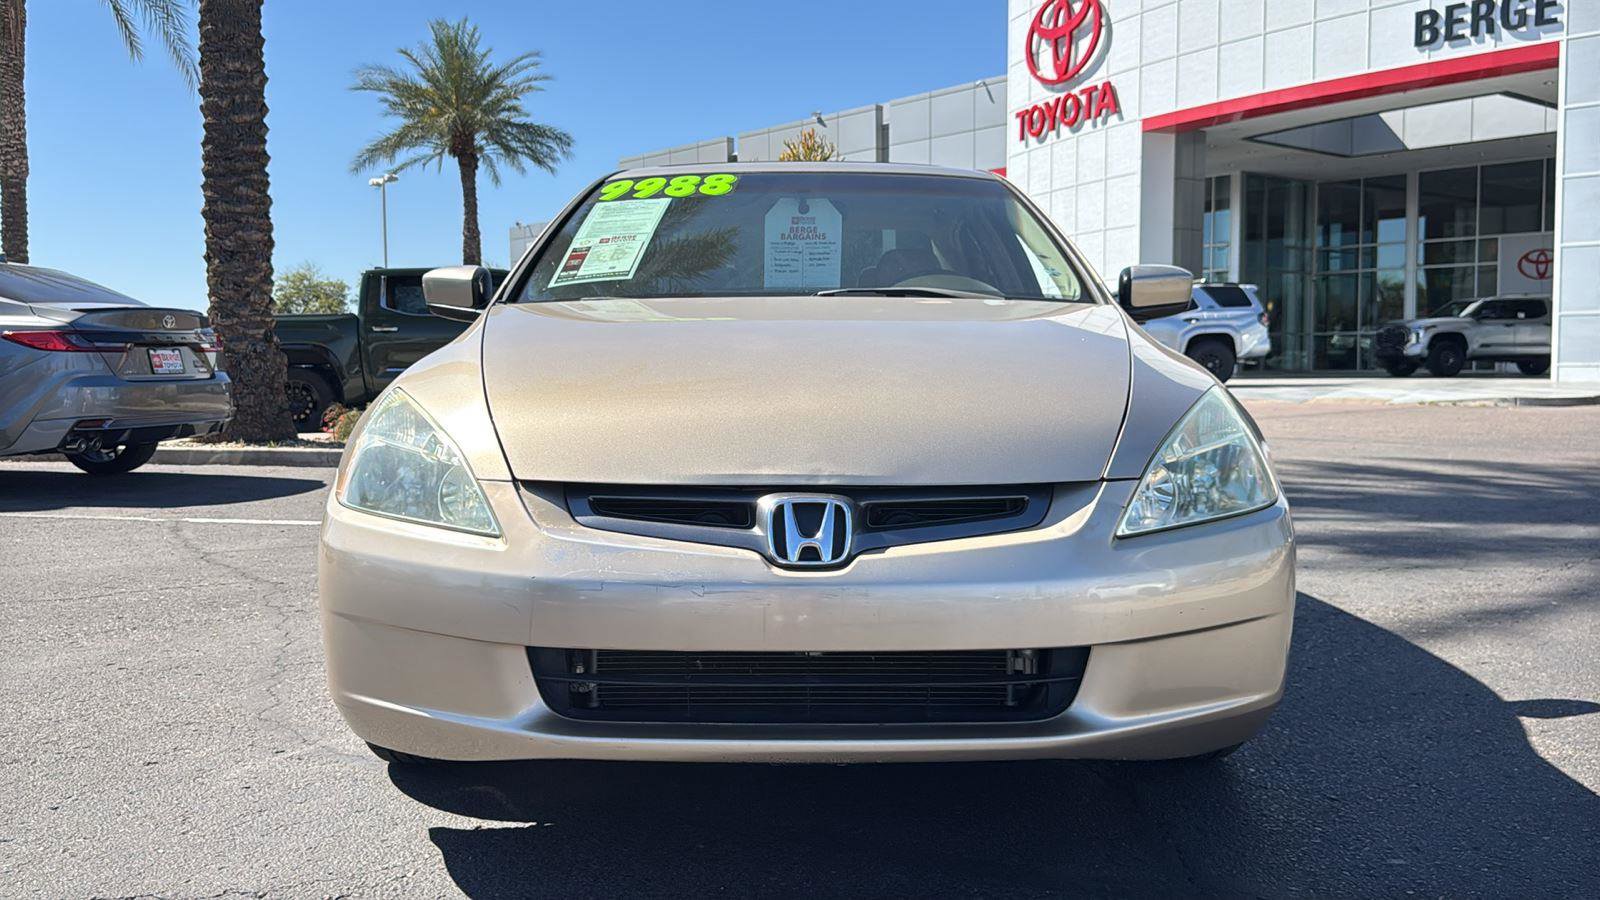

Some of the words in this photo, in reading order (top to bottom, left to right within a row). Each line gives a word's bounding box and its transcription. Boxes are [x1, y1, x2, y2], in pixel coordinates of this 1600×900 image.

[1414, 0, 1557, 47] BERGE
[1015, 81, 1118, 142] TOYOTA
[598, 174, 737, 202] 9988
[781, 233, 826, 241] BARGAINS
